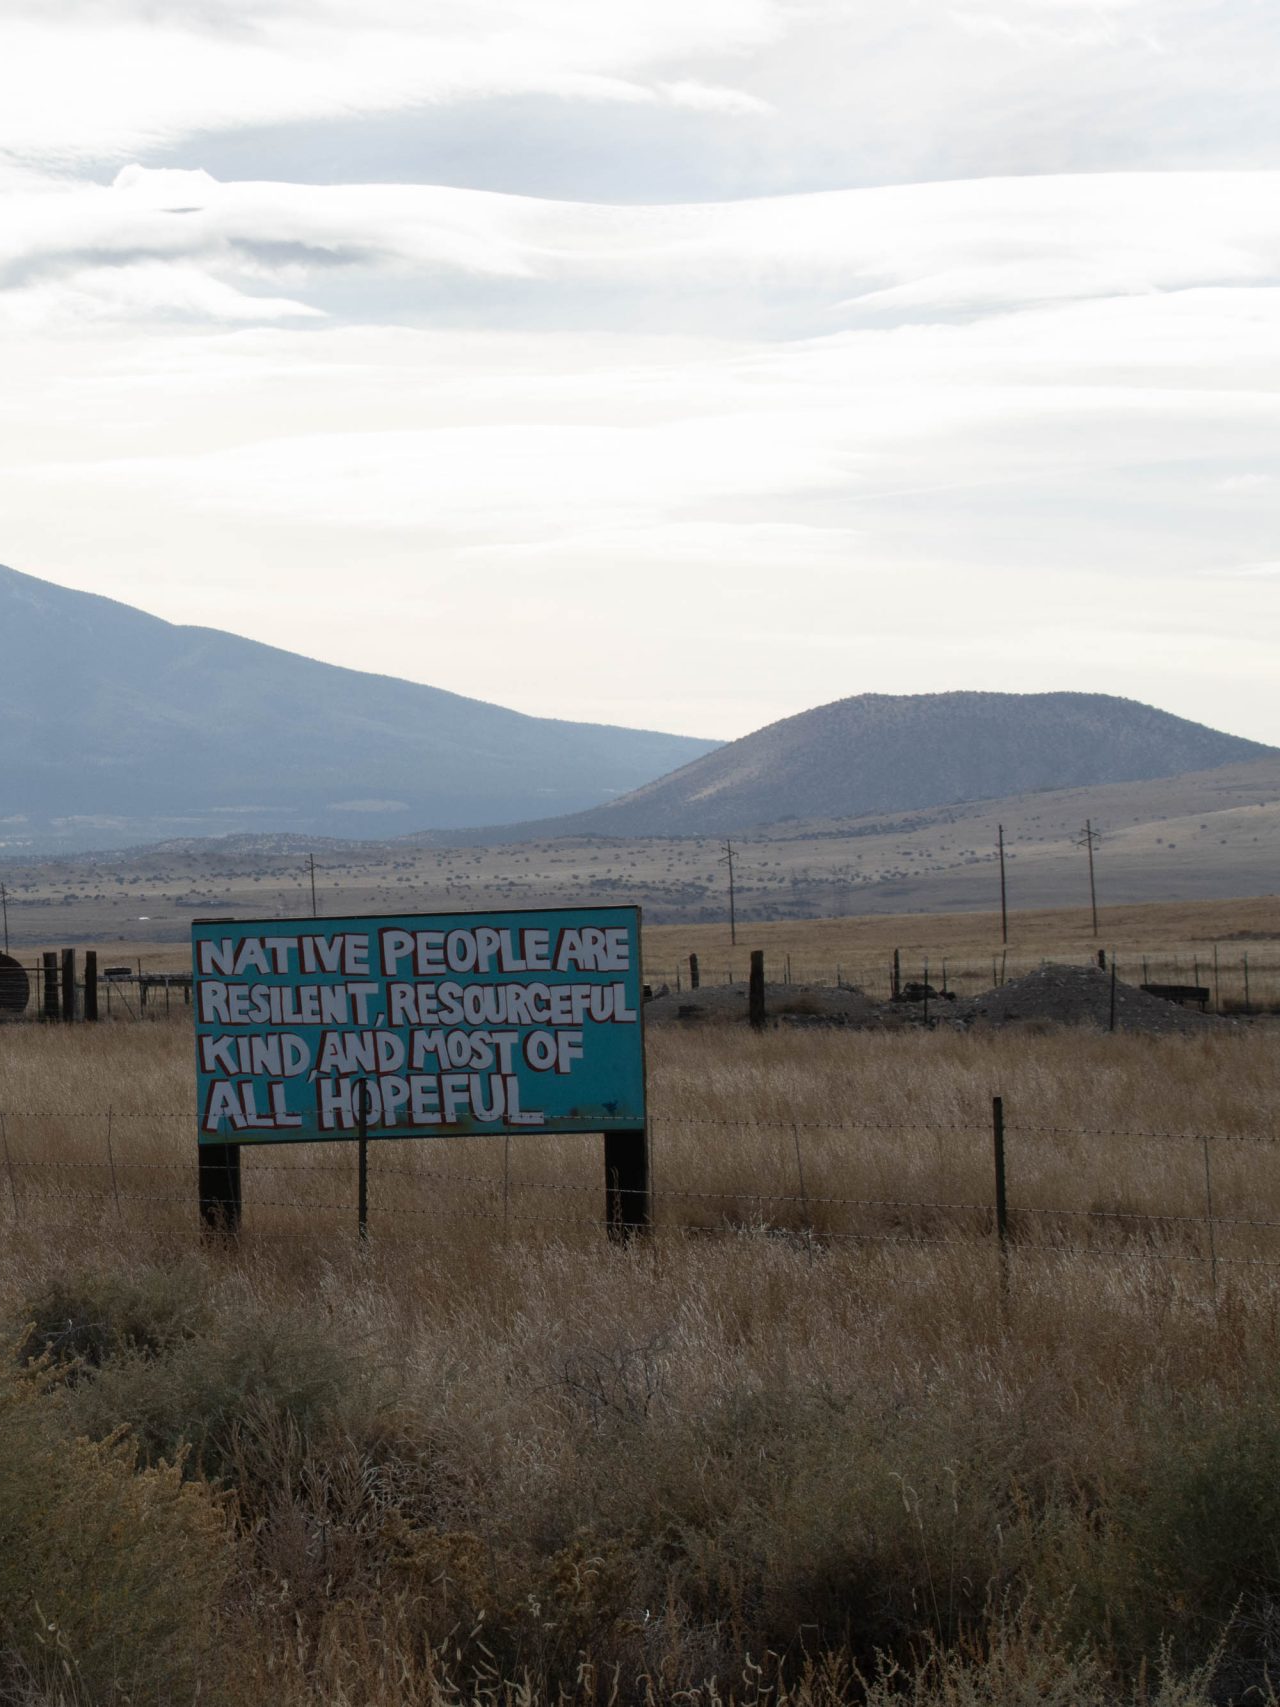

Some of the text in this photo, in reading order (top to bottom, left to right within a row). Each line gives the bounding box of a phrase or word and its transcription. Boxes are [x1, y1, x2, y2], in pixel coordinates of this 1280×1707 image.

[197, 925, 630, 976] NATIVE PEOPLE ARE
[386, 980, 637, 1027] RESOURCEFUL
[199, 1027, 584, 1084] KIND, AND MOST OF
[202, 1072, 545, 1133] ALL HOPEFUL
